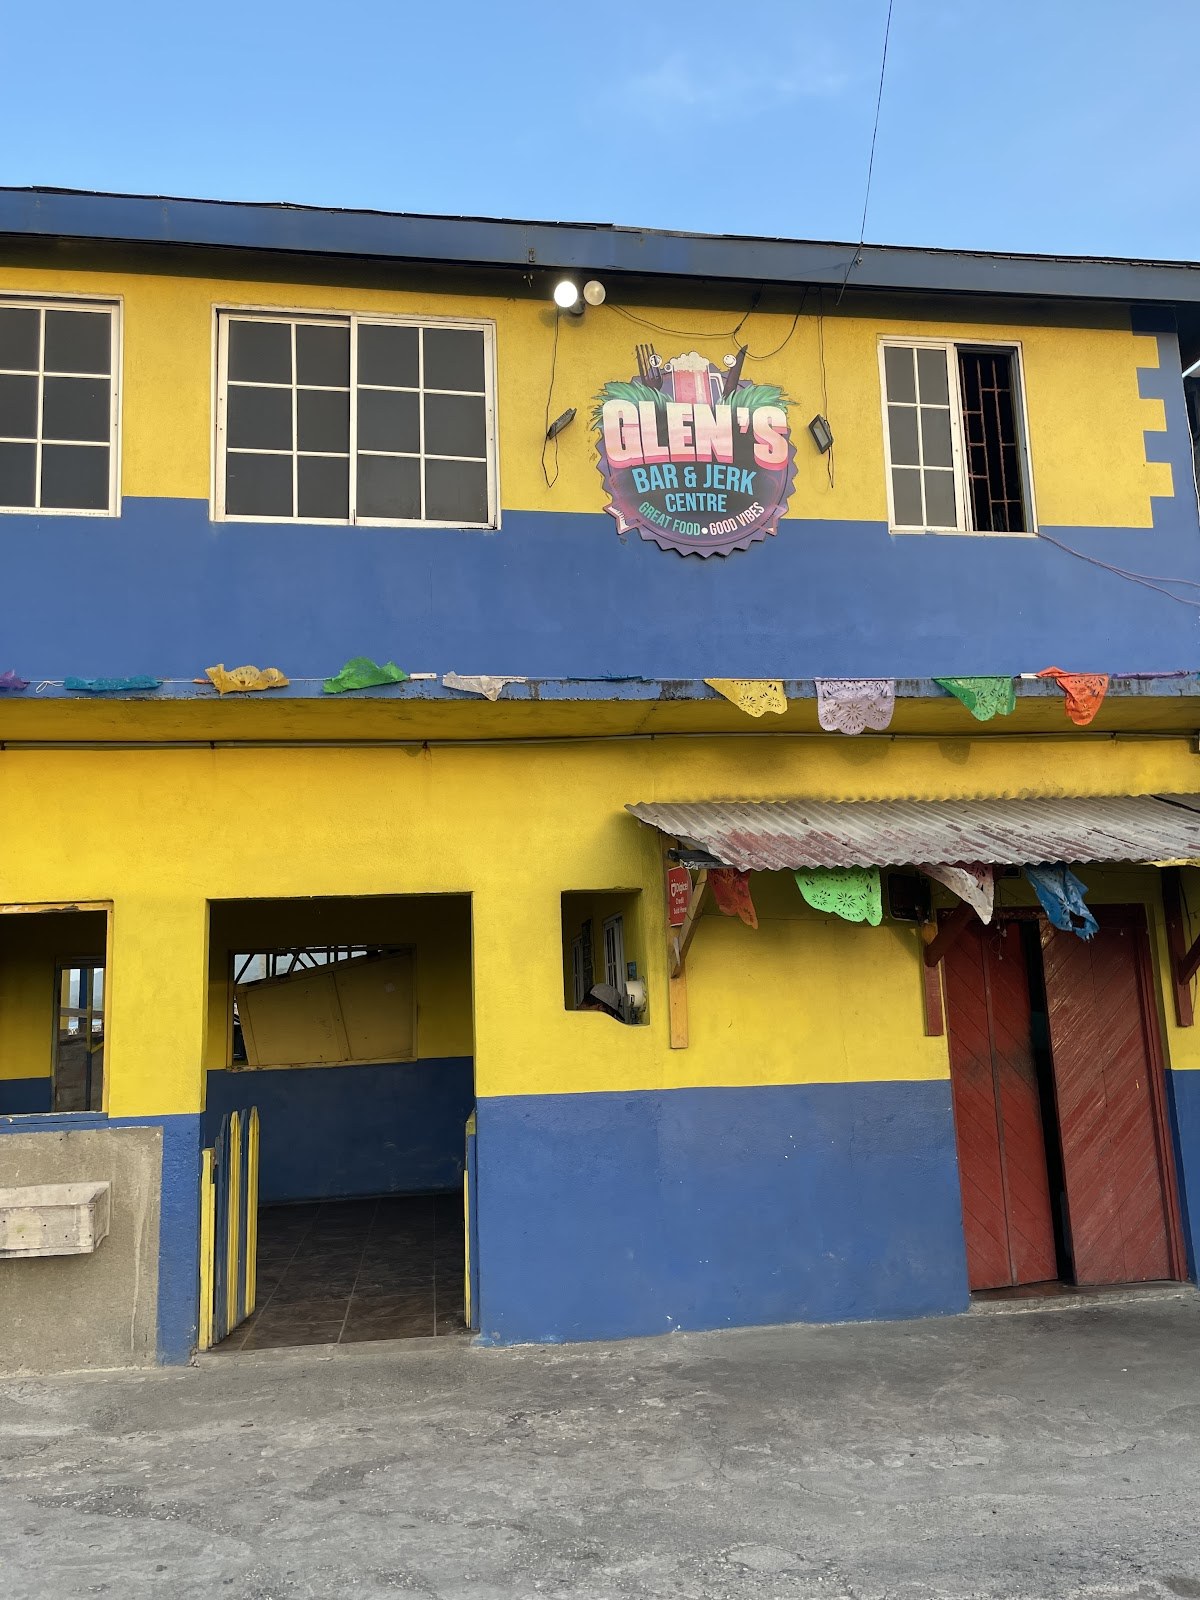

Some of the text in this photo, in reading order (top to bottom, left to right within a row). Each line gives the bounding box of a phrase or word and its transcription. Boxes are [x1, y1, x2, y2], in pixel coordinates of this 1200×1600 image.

[602, 399, 789, 470] GLEN'S
[631, 463, 757, 495] BAR & JERK
[638, 501, 765, 536] GREAT FOOD GOOD VIBES
[665, 492, 727, 513] CENTRE
